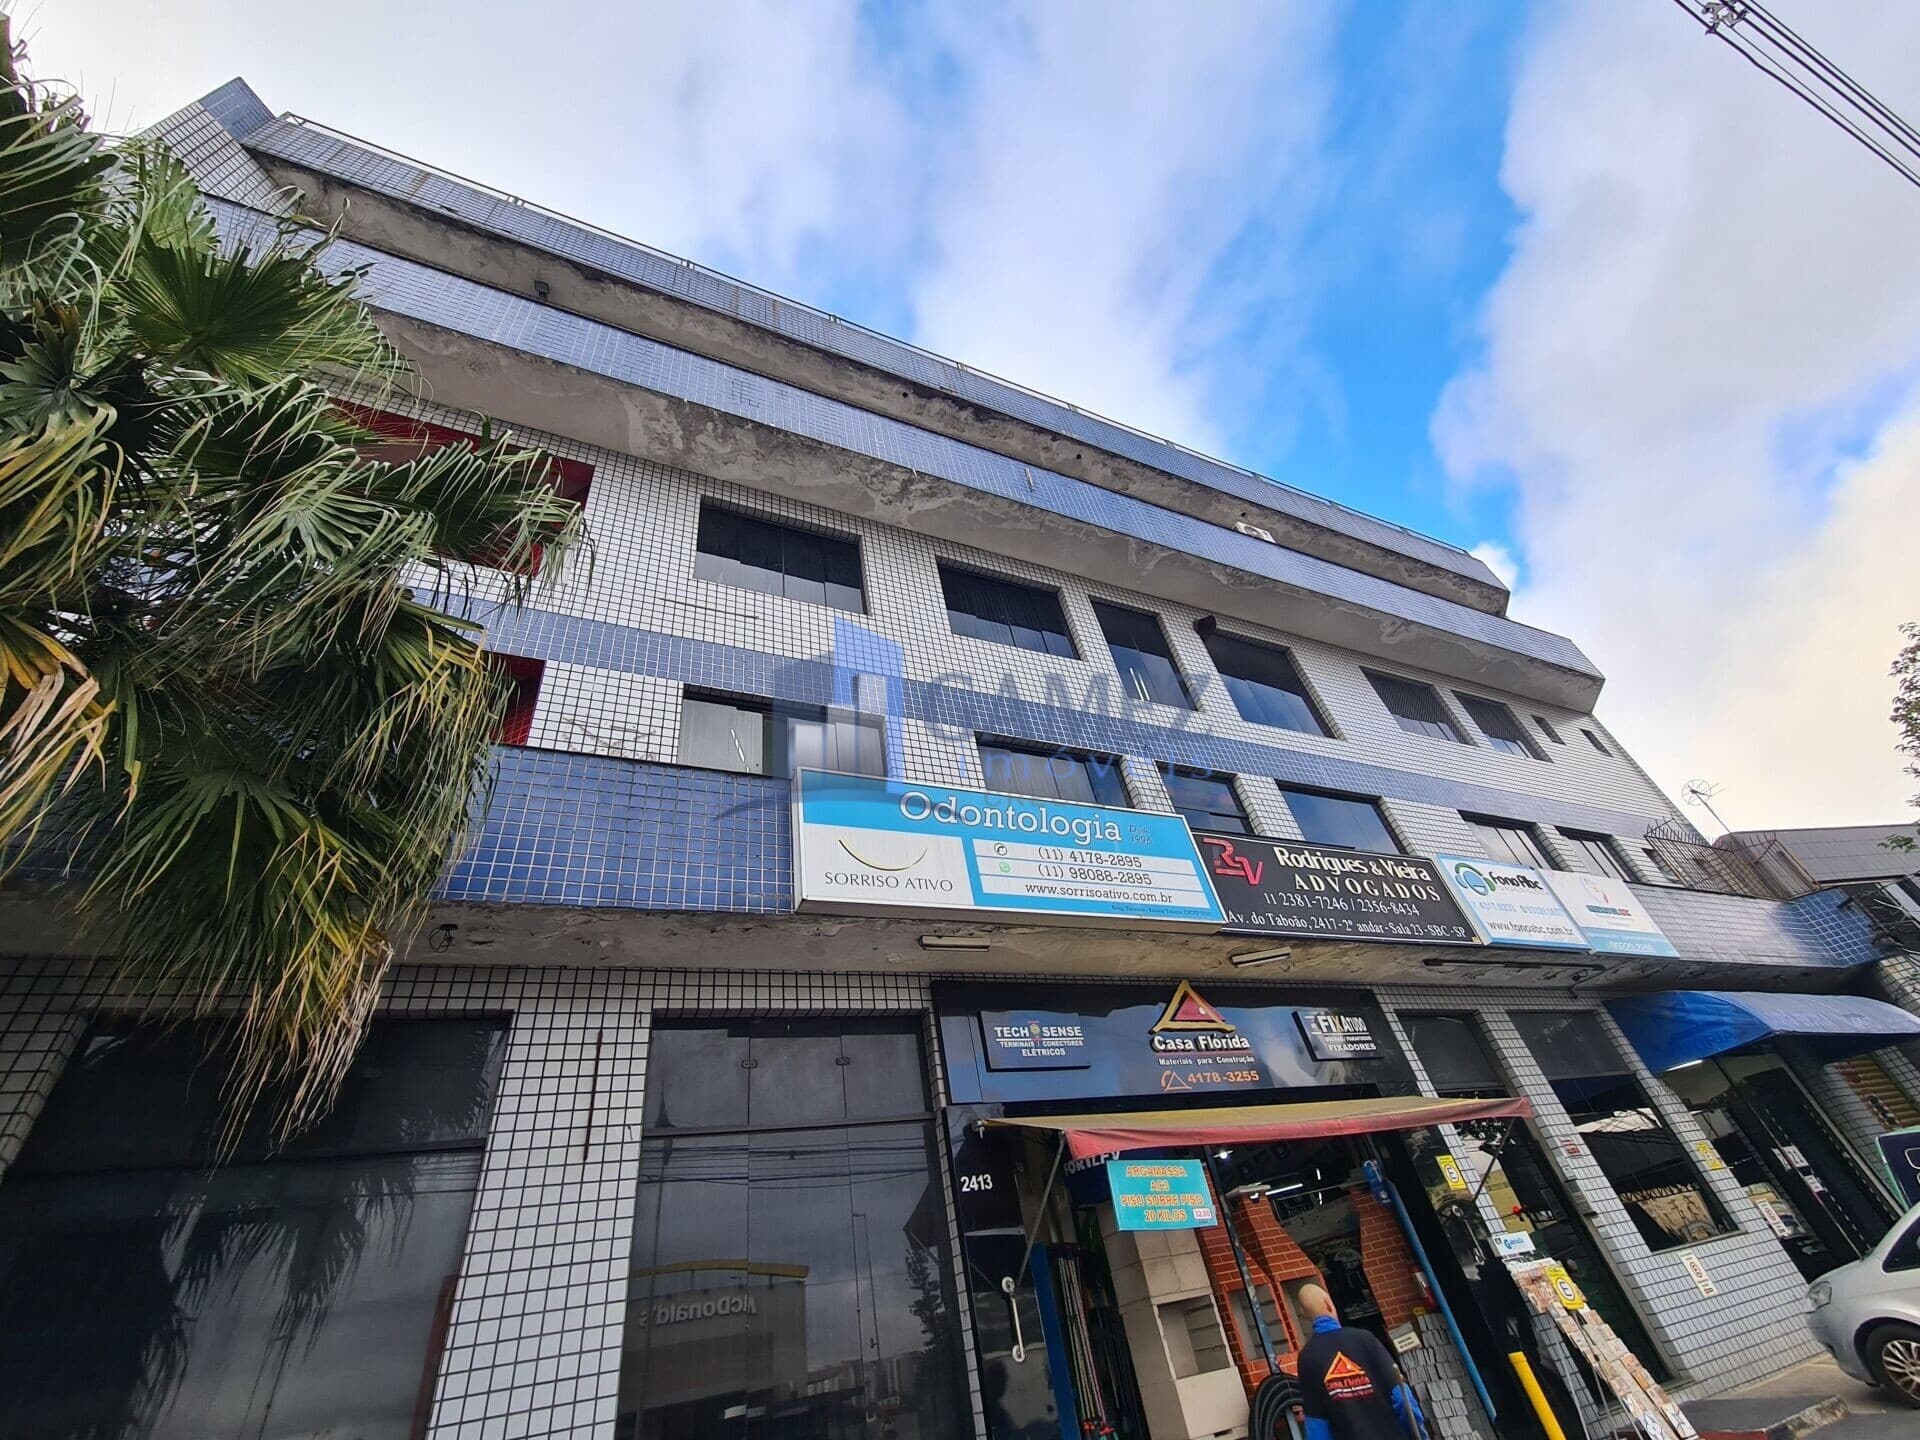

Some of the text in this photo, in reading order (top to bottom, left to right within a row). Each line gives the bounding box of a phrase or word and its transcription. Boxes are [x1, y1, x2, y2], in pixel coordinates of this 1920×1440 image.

[900, 791, 1122, 845] Odontologia
[1038, 847, 1142, 868] (11) 4178-2895
[1273, 846, 1432, 881] Rodrigues & Vieira
[824, 871, 953, 892] SORRISO ATIVO
[1038, 864, 1152, 886] (11) 98088-2895
[1025, 883, 1173, 904] www.sorrisoativo.com.br
[1294, 873, 1441, 902] ADVOGADOS
[1264, 893, 1277, 905] 11
[1279, 892, 1349, 911] 2381-7246
[1357, 899, 1420, 916] 2356-8434
[1228, 910, 1249, 923] Av.
[1251, 912, 1265, 925] do
[994, 1026, 1083, 1038] TECH SENSE
[1153, 1033, 1251, 1050] Casa Flórida
[1328, 1043, 1377, 1052] FIXADORES
[1021, 1047, 1066, 1057] ELÉTRICOS
[1159, 1055, 1255, 1066] Materiais para Construção
[1187, 1070, 1260, 1084] 4178-3255
[1126, 1165, 1188, 1177] ARGAMASSA
[960, 1174, 993, 1192] 2413
[1120, 1193, 1204, 1207] PISO SOBRE PISO
[1144, 1209, 1187, 1222] 20 KILOS
